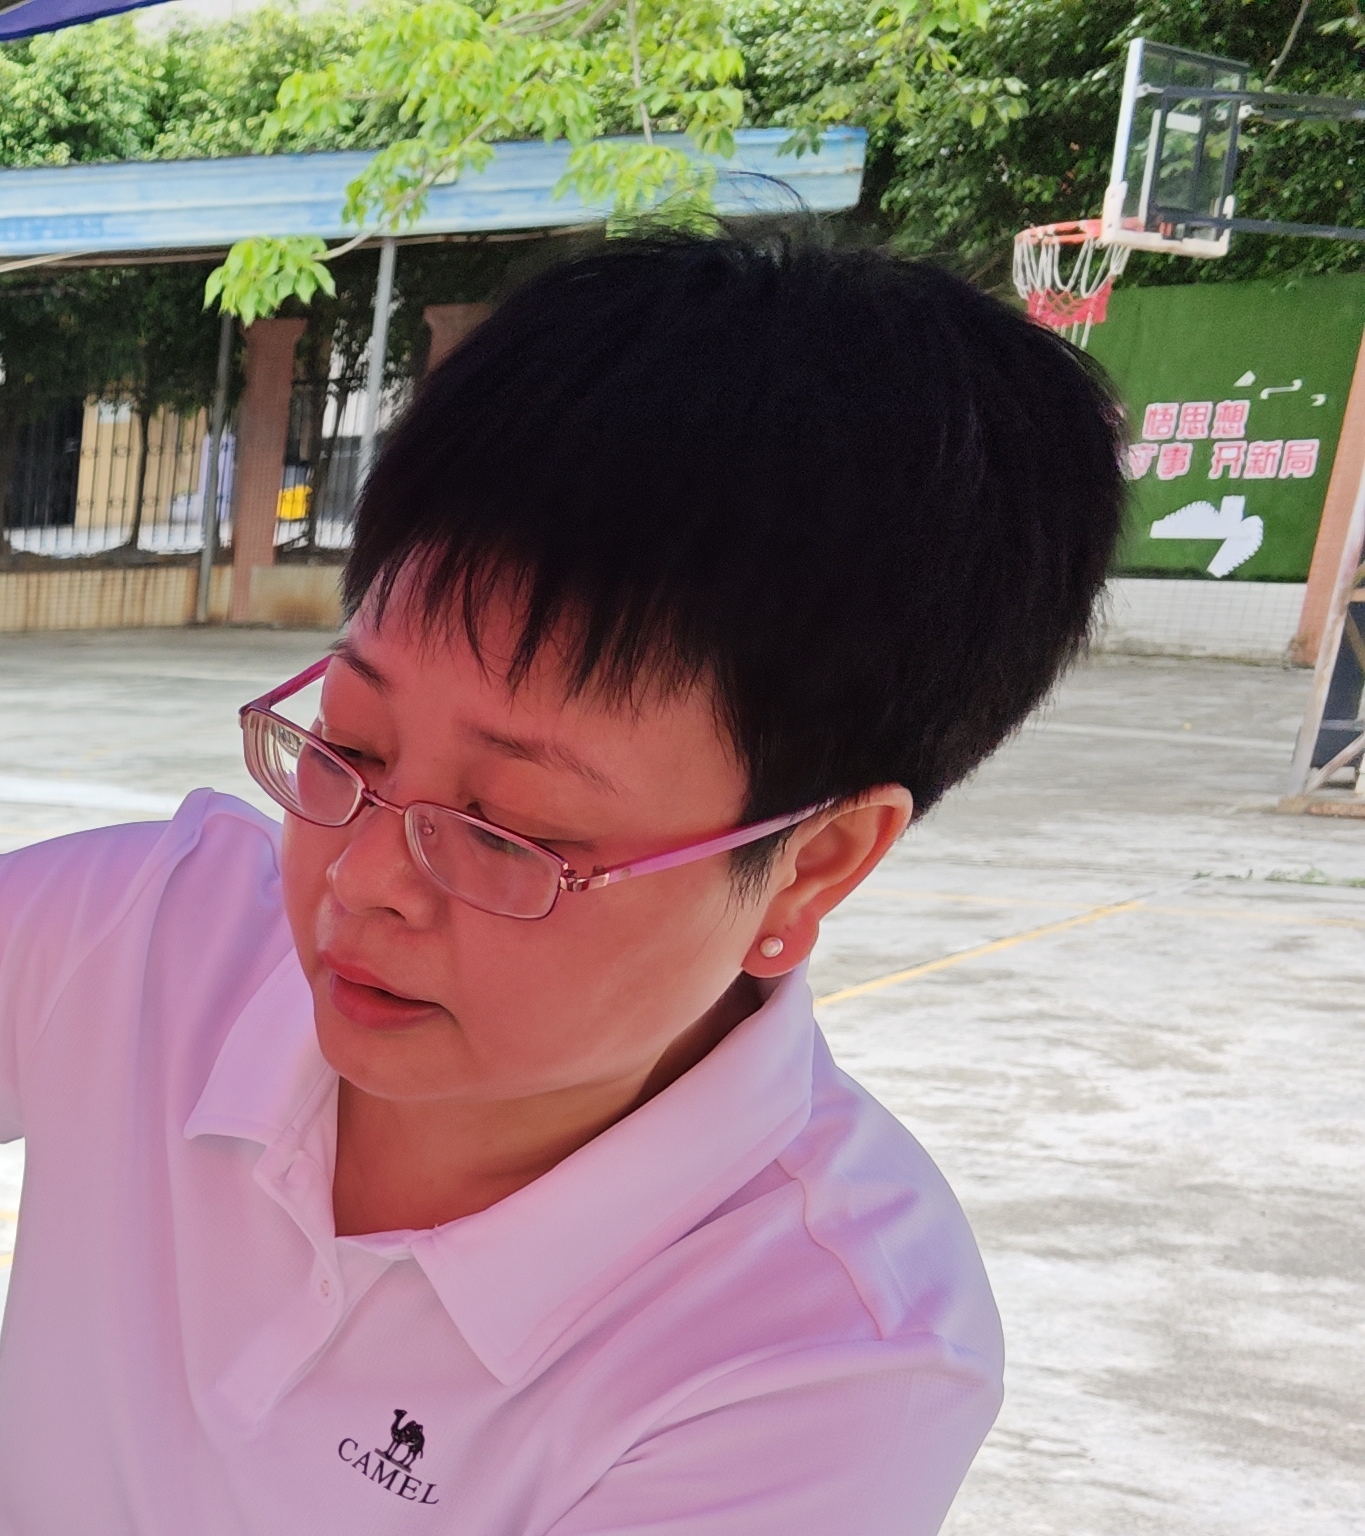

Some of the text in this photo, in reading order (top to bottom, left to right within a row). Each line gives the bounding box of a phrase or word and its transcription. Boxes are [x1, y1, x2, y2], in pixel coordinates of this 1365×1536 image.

[1142, 400, 1250, 439] 悟思想
[1208, 439, 1319, 479] 开新局
[338, 1438, 439, 1505] CAMEL
